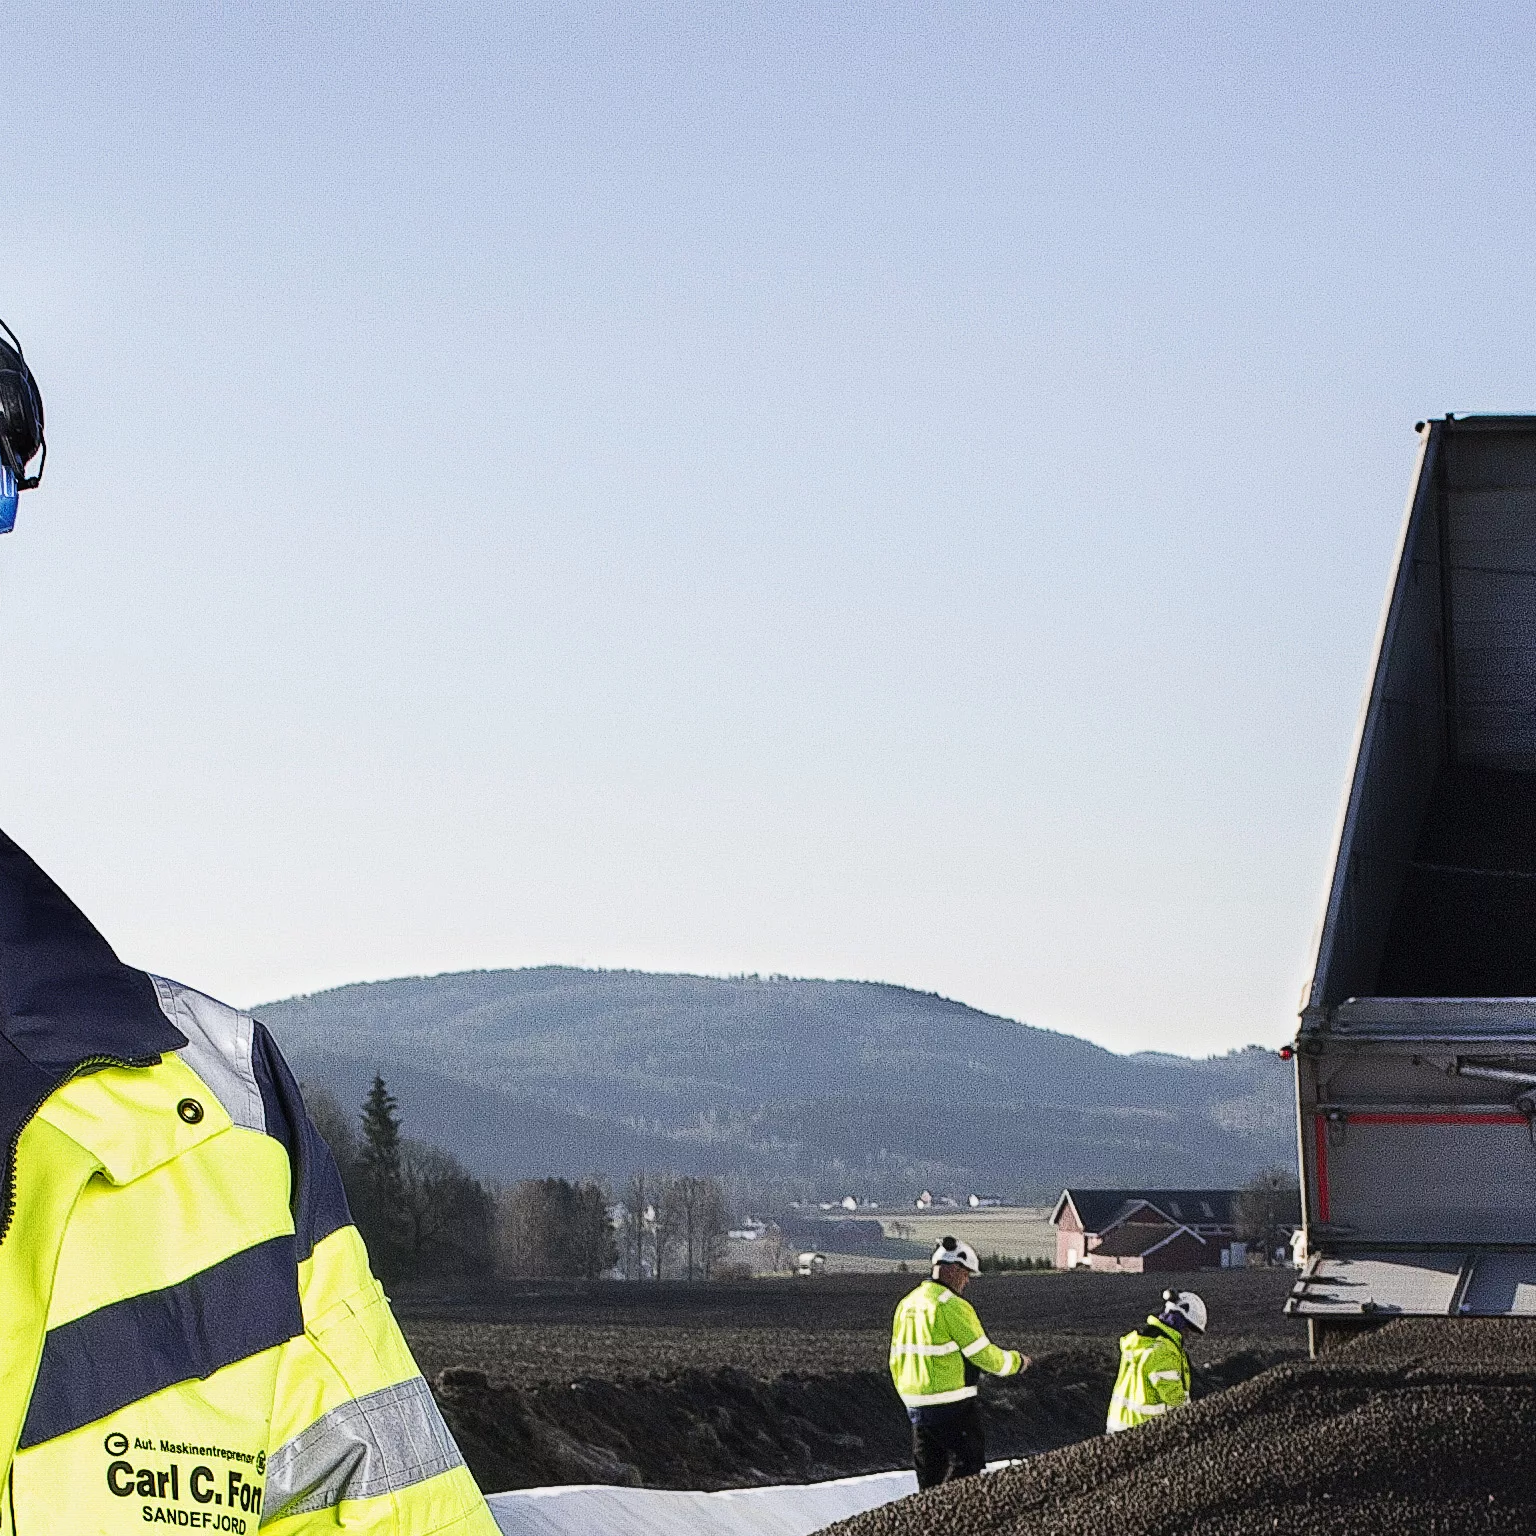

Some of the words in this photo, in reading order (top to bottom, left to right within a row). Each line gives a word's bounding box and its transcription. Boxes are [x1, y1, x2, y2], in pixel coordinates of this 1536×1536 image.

[134, 1437, 156, 1451] Aut.
[106, 1460, 179, 1501] Carl
[189, 1465, 222, 1505] C.
[142, 1505, 247, 1536] SANDEFJORD
